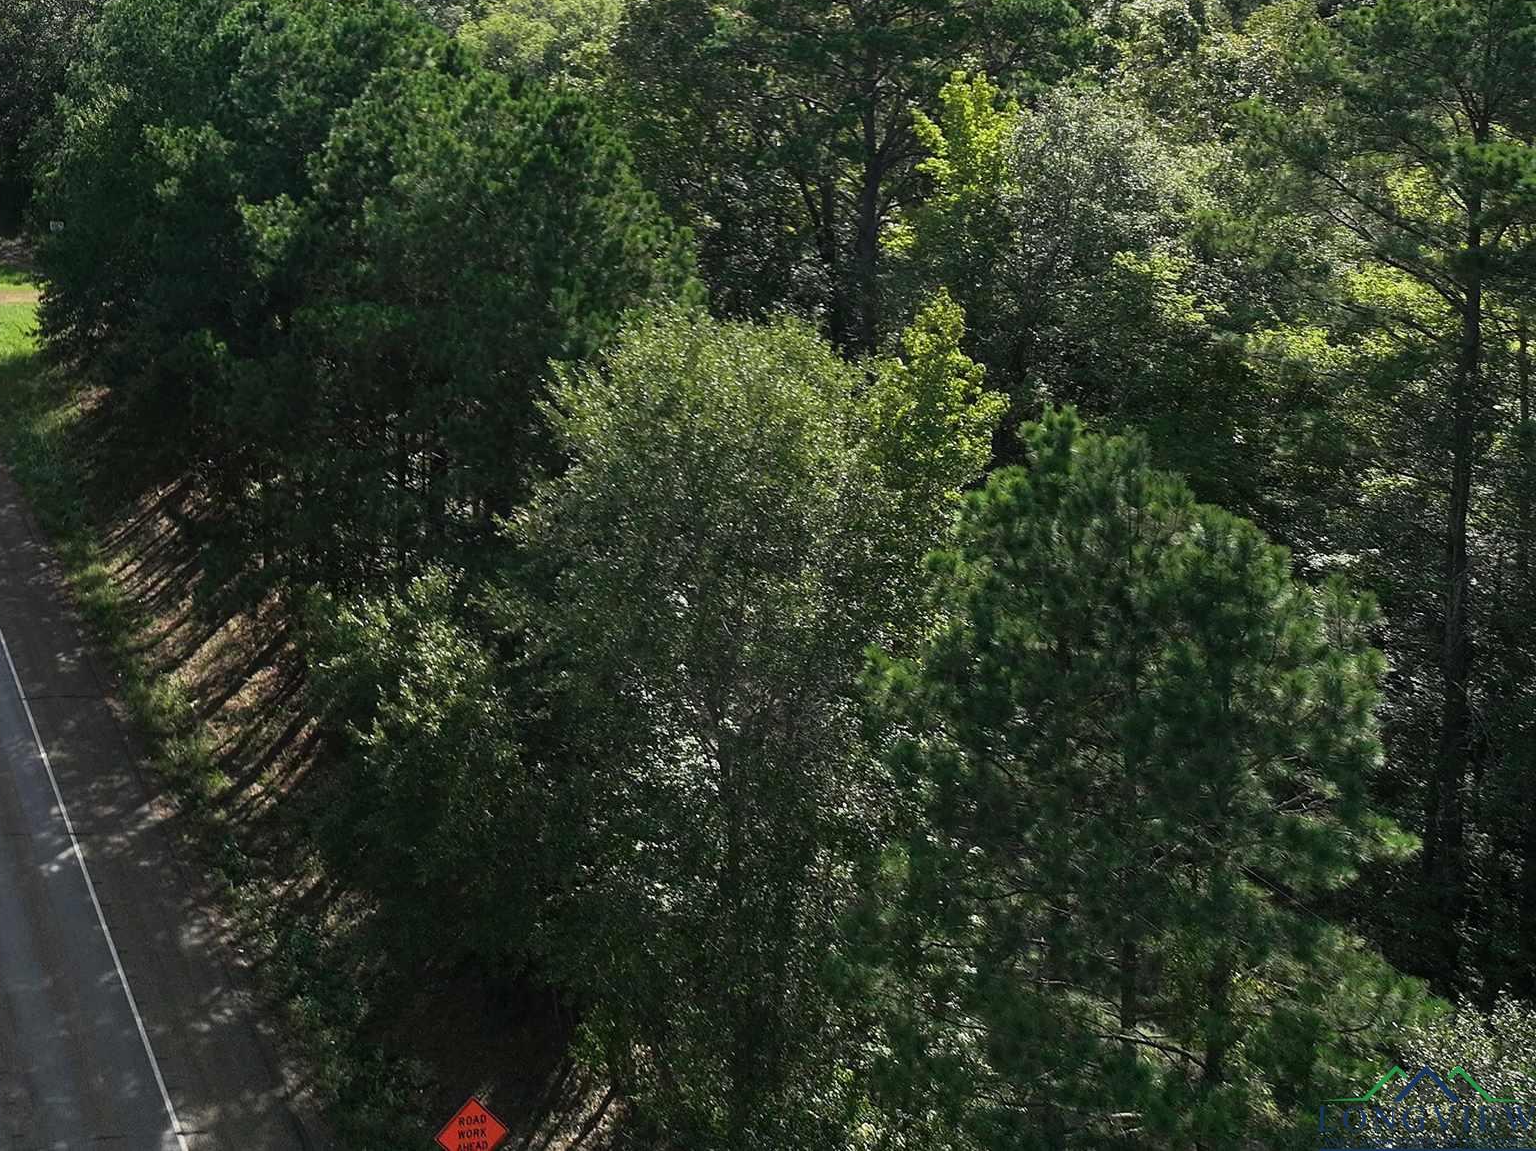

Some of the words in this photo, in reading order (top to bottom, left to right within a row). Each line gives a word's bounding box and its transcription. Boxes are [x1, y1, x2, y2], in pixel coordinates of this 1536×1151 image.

[458, 1114, 487, 1127] ROAD
[457, 1129, 487, 1139] WORK
[457, 1140, 489, 1151] AHEAD
